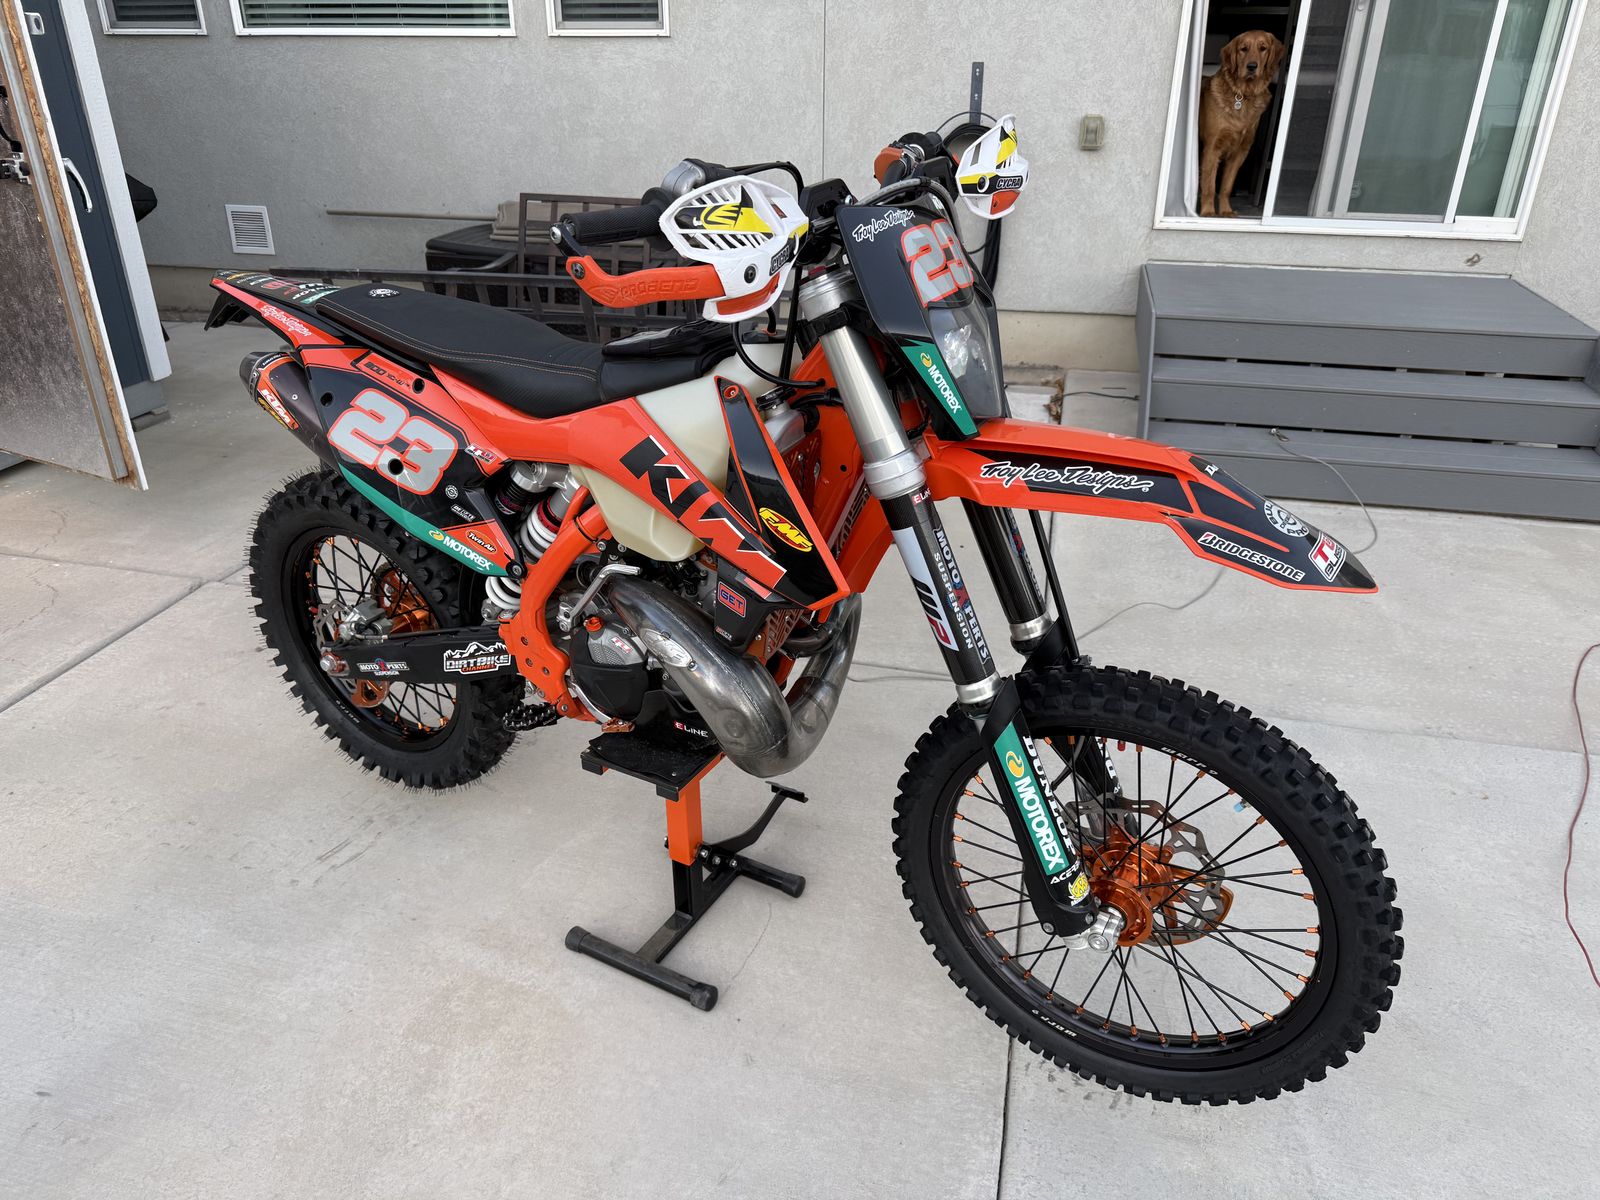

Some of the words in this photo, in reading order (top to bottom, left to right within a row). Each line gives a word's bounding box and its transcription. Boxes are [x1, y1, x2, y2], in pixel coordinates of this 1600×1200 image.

[996, 178, 1020, 189] CYCRA
[852, 224, 875, 242] Troy
[871, 219, 889, 234] Lee
[901, 219, 974, 308] 23
[928, 364, 962, 413] MOTOREX
[328, 388, 459, 496] 23
[980, 461, 1022, 487] Troy
[1020, 463, 1061, 482] Lee
[1060, 467, 1154, 494] Designs
[443, 535, 493, 570] MOTOREX
[759, 508, 813, 552] FMF
[937, 531, 961, 583] MOTO
[1199, 532, 1305, 581] BRIDGESTONE
[720, 586, 745, 610] GET
[934, 552, 973, 649] SUSPENSION
[462, 664, 496, 673] CHANNEL
[1014, 775, 1066, 871] MOTOREX
